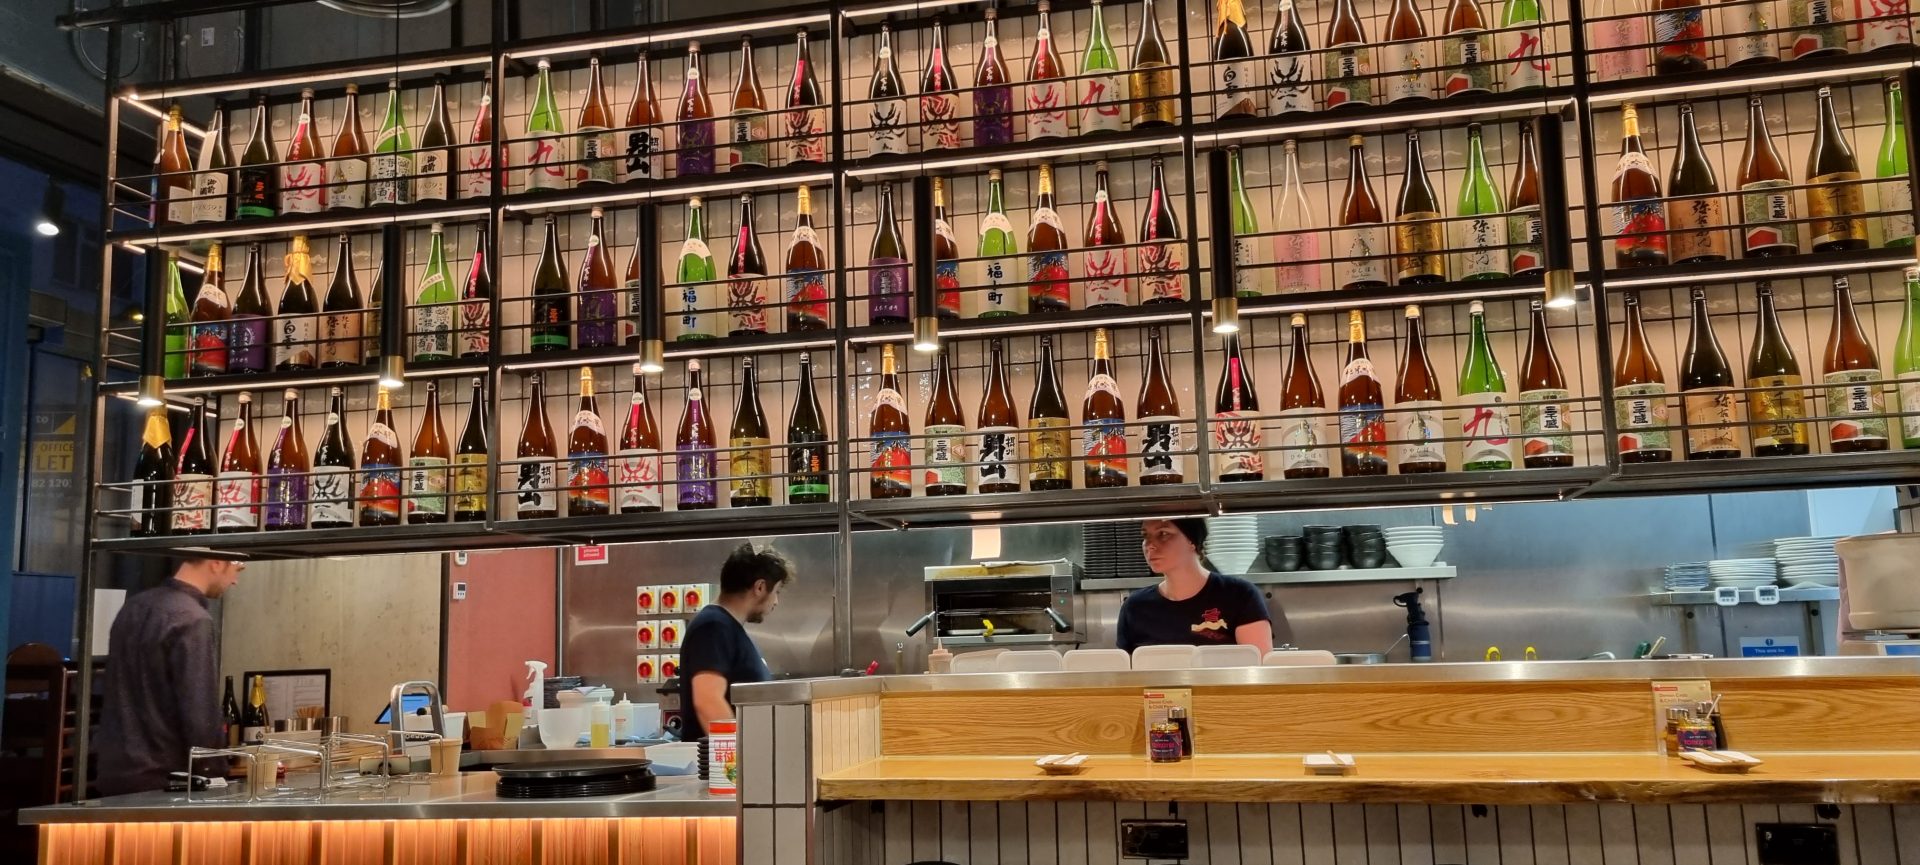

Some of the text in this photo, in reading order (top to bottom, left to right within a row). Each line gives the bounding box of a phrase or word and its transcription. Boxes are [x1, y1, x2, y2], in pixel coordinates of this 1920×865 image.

[1507, 32, 1551, 75] 九
[1081, 80, 1120, 121] 九
[528, 139, 565, 177] 九
[1463, 406, 1508, 447] 九
